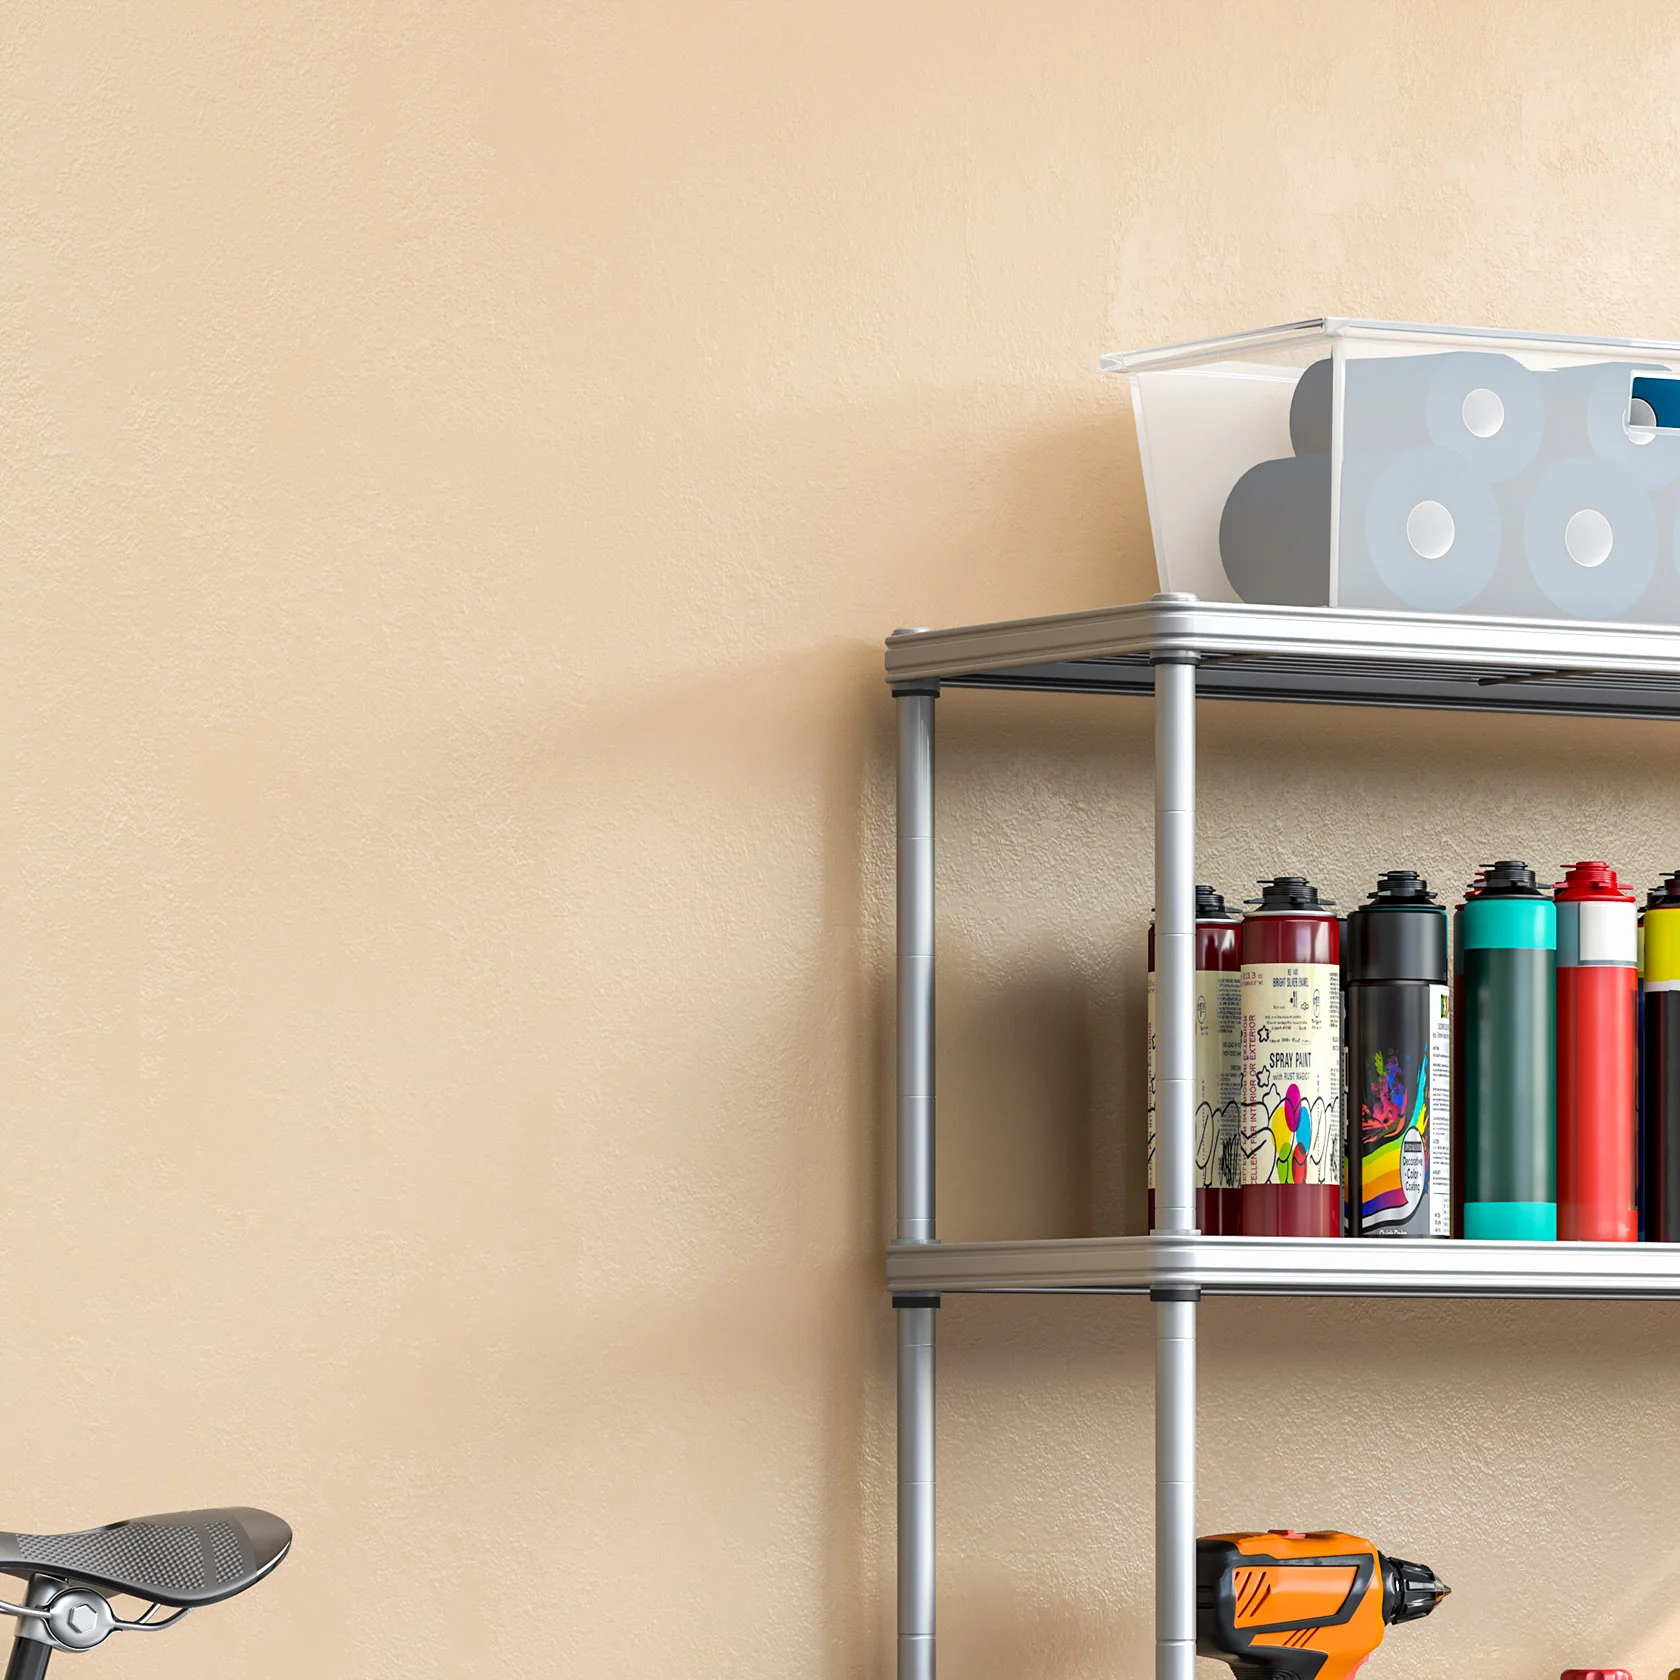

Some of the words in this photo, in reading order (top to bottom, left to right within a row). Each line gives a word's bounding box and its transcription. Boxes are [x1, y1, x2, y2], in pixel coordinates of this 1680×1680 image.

[1269, 1052, 1294, 1068] SPRAY
[1295, 1052, 1311, 1068] PAINT
[1250, 1063, 1257, 1077] OR
[1402, 1156, 1423, 1166] Decorative
[1406, 1168, 1419, 1180] Color
[1405, 1181, 1420, 1193] Coating
